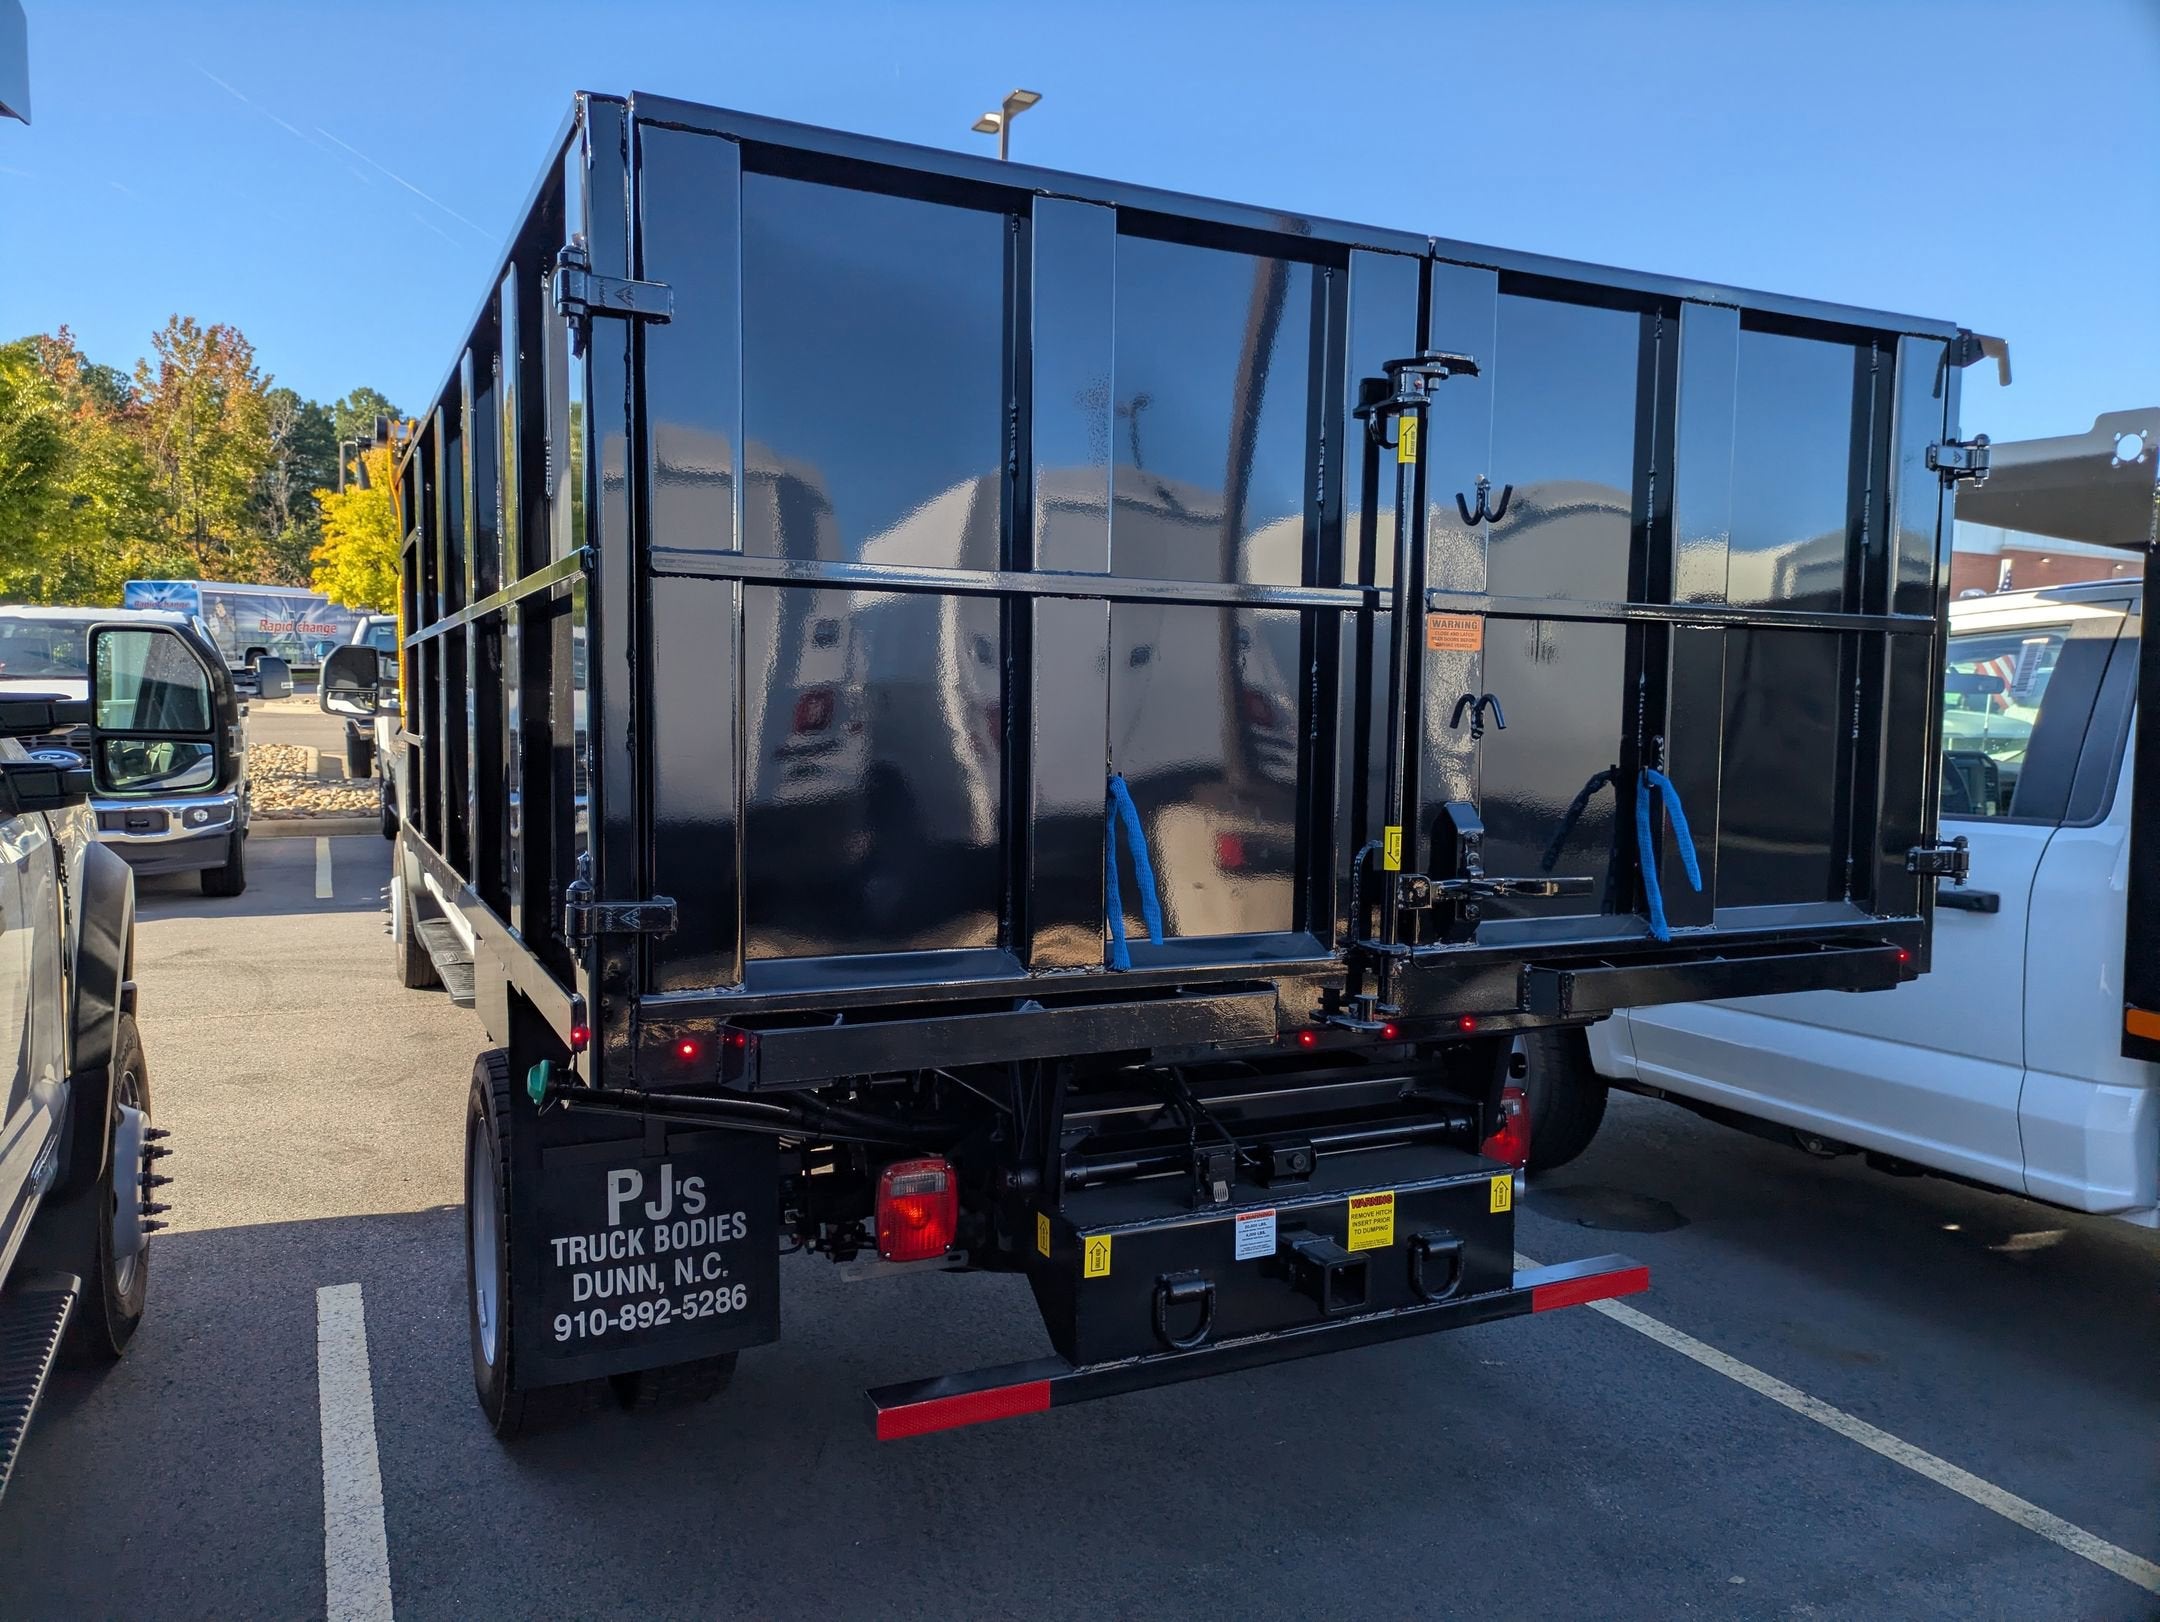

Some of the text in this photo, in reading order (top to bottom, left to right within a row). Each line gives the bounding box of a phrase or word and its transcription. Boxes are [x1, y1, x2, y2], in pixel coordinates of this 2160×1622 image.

[259, 619, 293, 634] Rapid
[297, 620, 337, 635] change
[1432, 619, 1478, 629] WARNING
[1350, 1194, 1393, 1209] WARNING
[1351, 1211, 1375, 1220] REMOVE
[1352, 1219, 1372, 1227] INSERT
[1363, 1225, 1388, 1234] DUMPING
[551, 1211, 747, 1267] TRUCK BODIES
[573, 1252, 729, 1302] DUNN, N.C.
[553, 1283, 748, 1342] 910-892-5286
